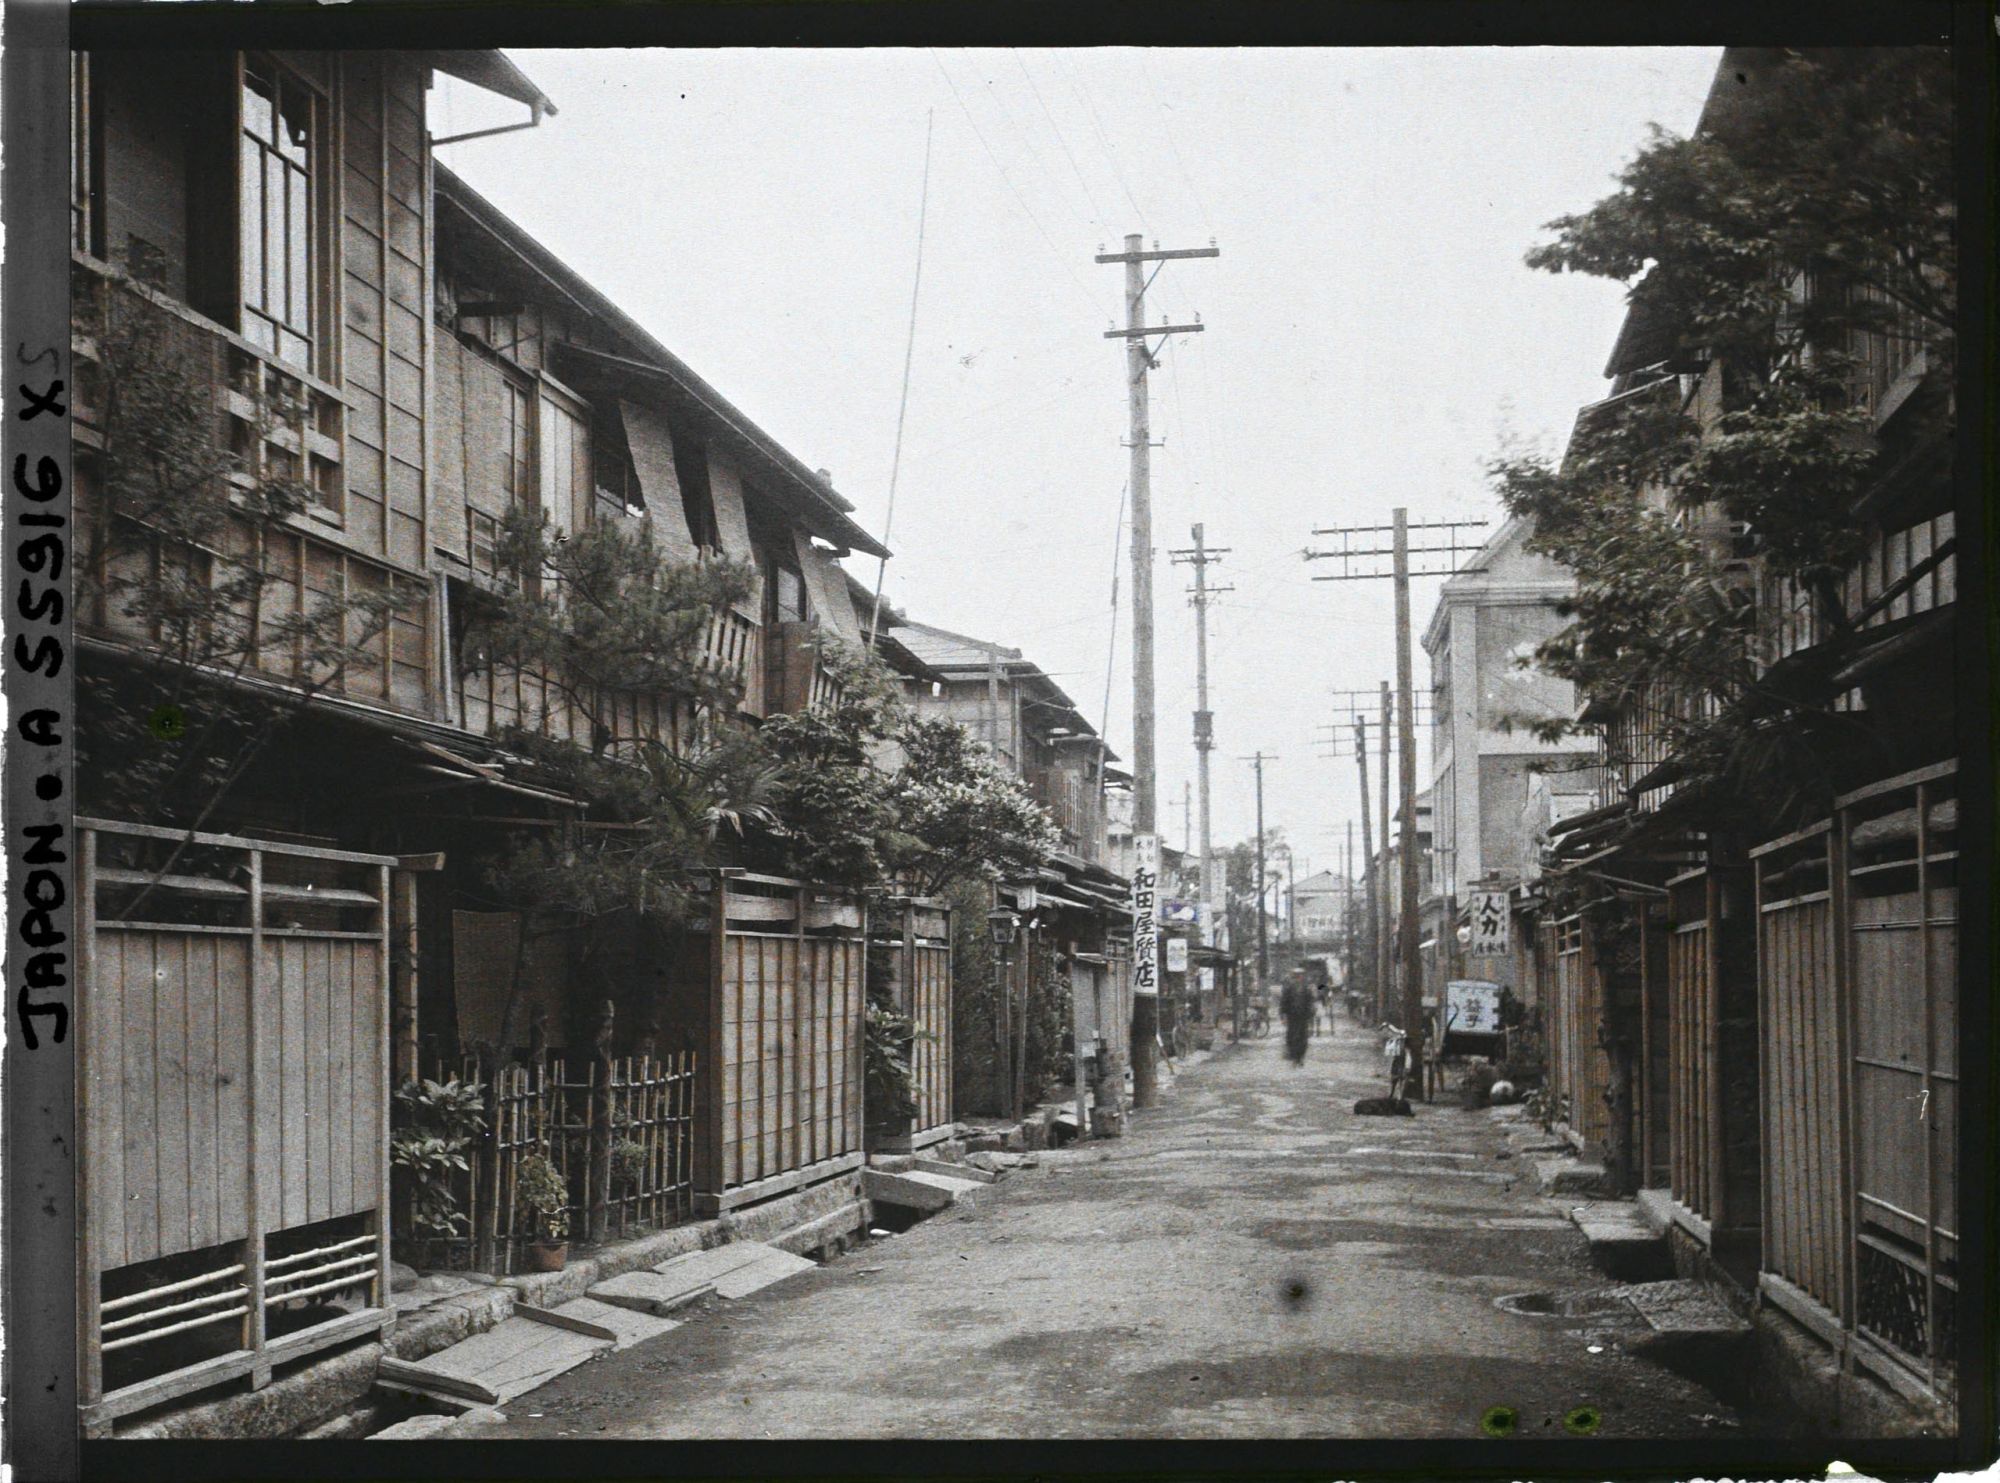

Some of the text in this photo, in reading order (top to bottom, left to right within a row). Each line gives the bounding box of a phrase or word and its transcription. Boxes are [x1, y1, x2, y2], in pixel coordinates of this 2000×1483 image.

[18, 709, 63, 747] A
[18, 824, 68, 1050] JAPON
[1134, 867, 1156, 988] 和田屋質店
[1480, 895, 1500, 936] 人力
